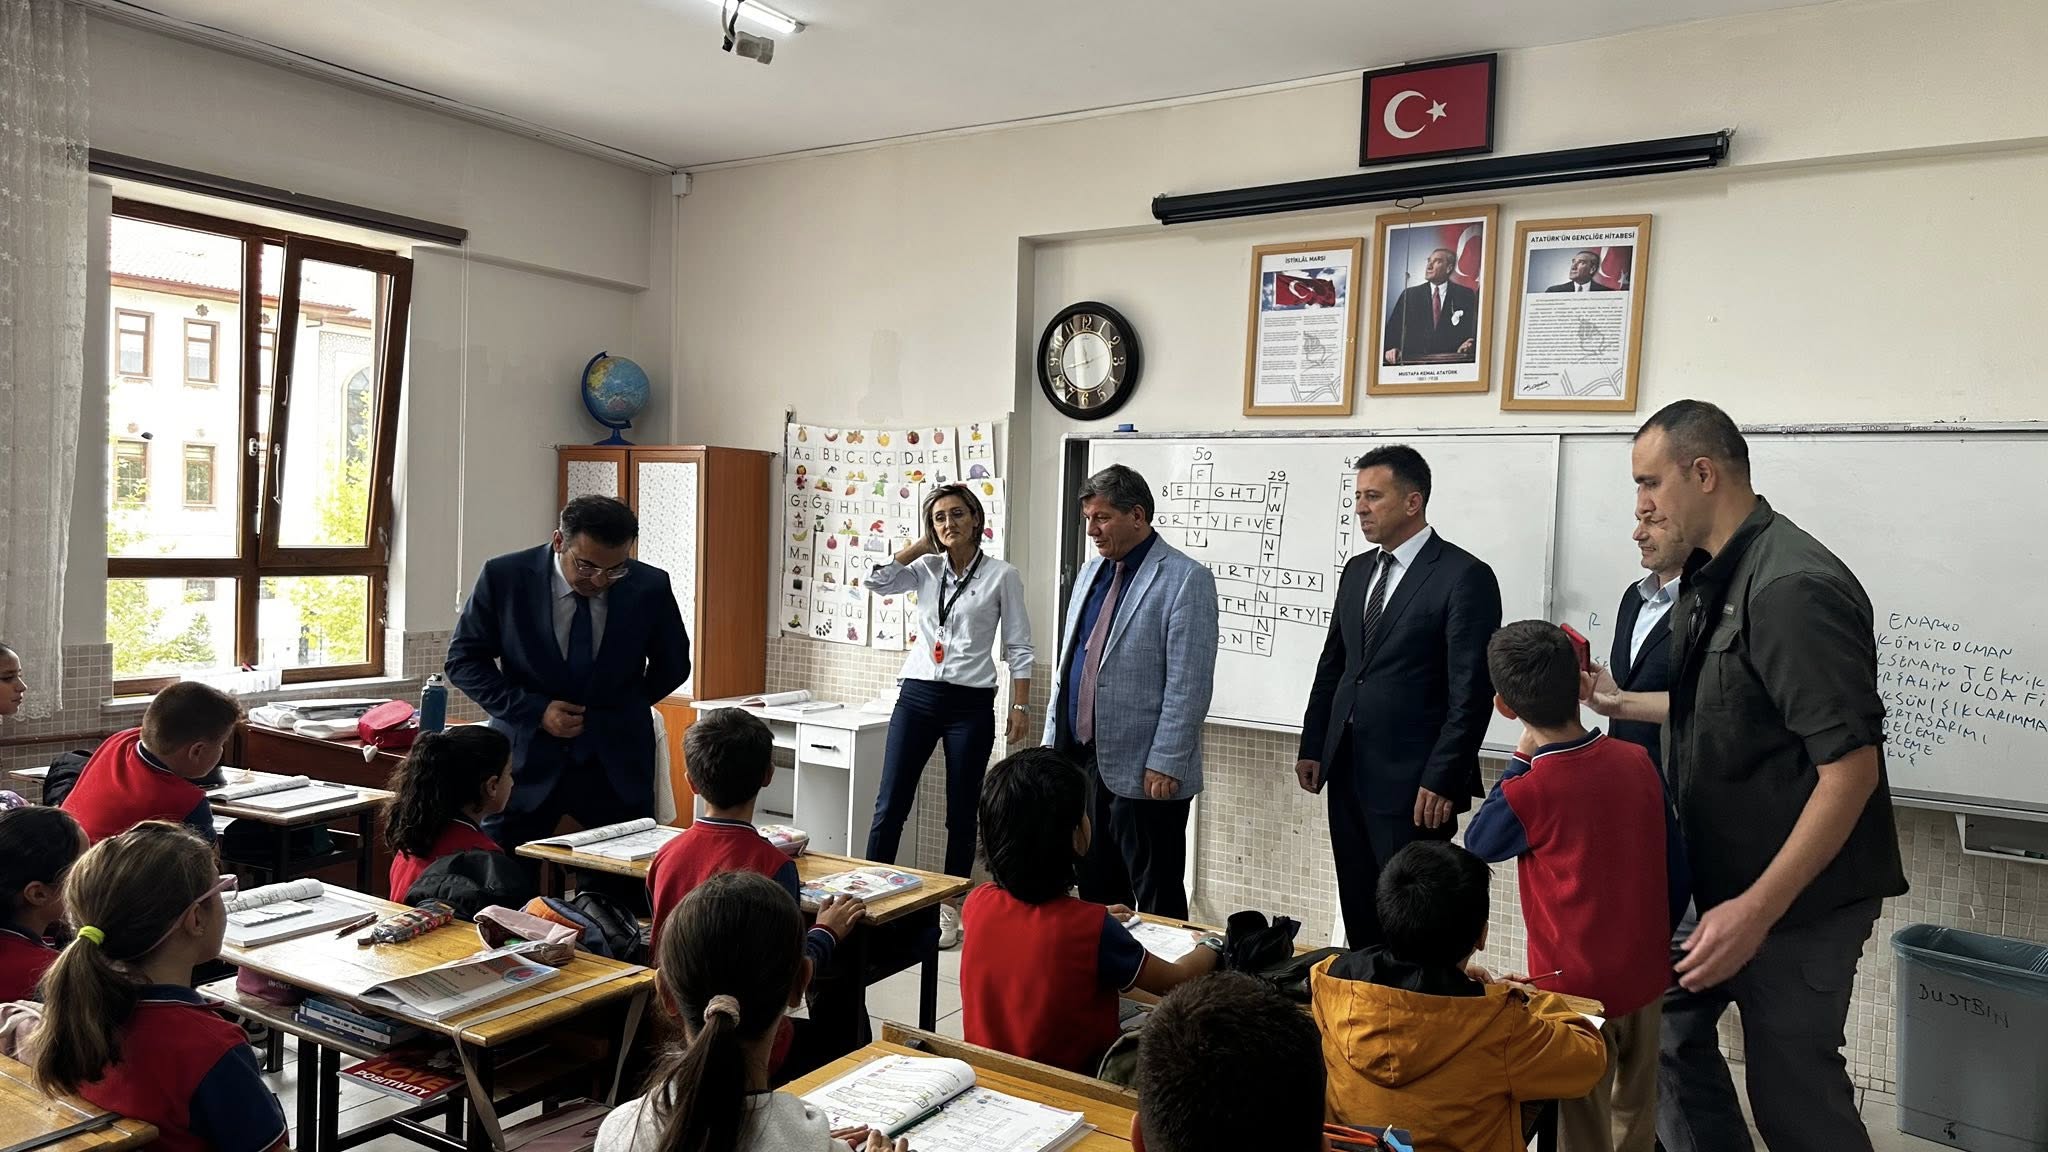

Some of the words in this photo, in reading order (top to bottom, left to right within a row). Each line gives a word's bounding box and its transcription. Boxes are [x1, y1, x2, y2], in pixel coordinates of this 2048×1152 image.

[1531, 234, 1571, 243] ATATÜRK'ÜN
[1571, 232, 1604, 242] GENÇLİĞE
[1604, 231, 1635, 240] HİTABESİ
[1193, 447, 1212, 461] 50
[1268, 470, 1287, 482] 29
[1162, 486, 1169, 497] 8
[1176, 485, 1257, 500] EIGHT
[1158, 515, 1220, 528] ORTY
[1233, 516, 1276, 530] FIVE
[1281, 571, 1317, 588] SIX
[1877, 633, 1947, 652] KÖMÜR
[353, 1069, 430, 1096] POSITIVITY
[367, 1061, 449, 1090] LOVE
